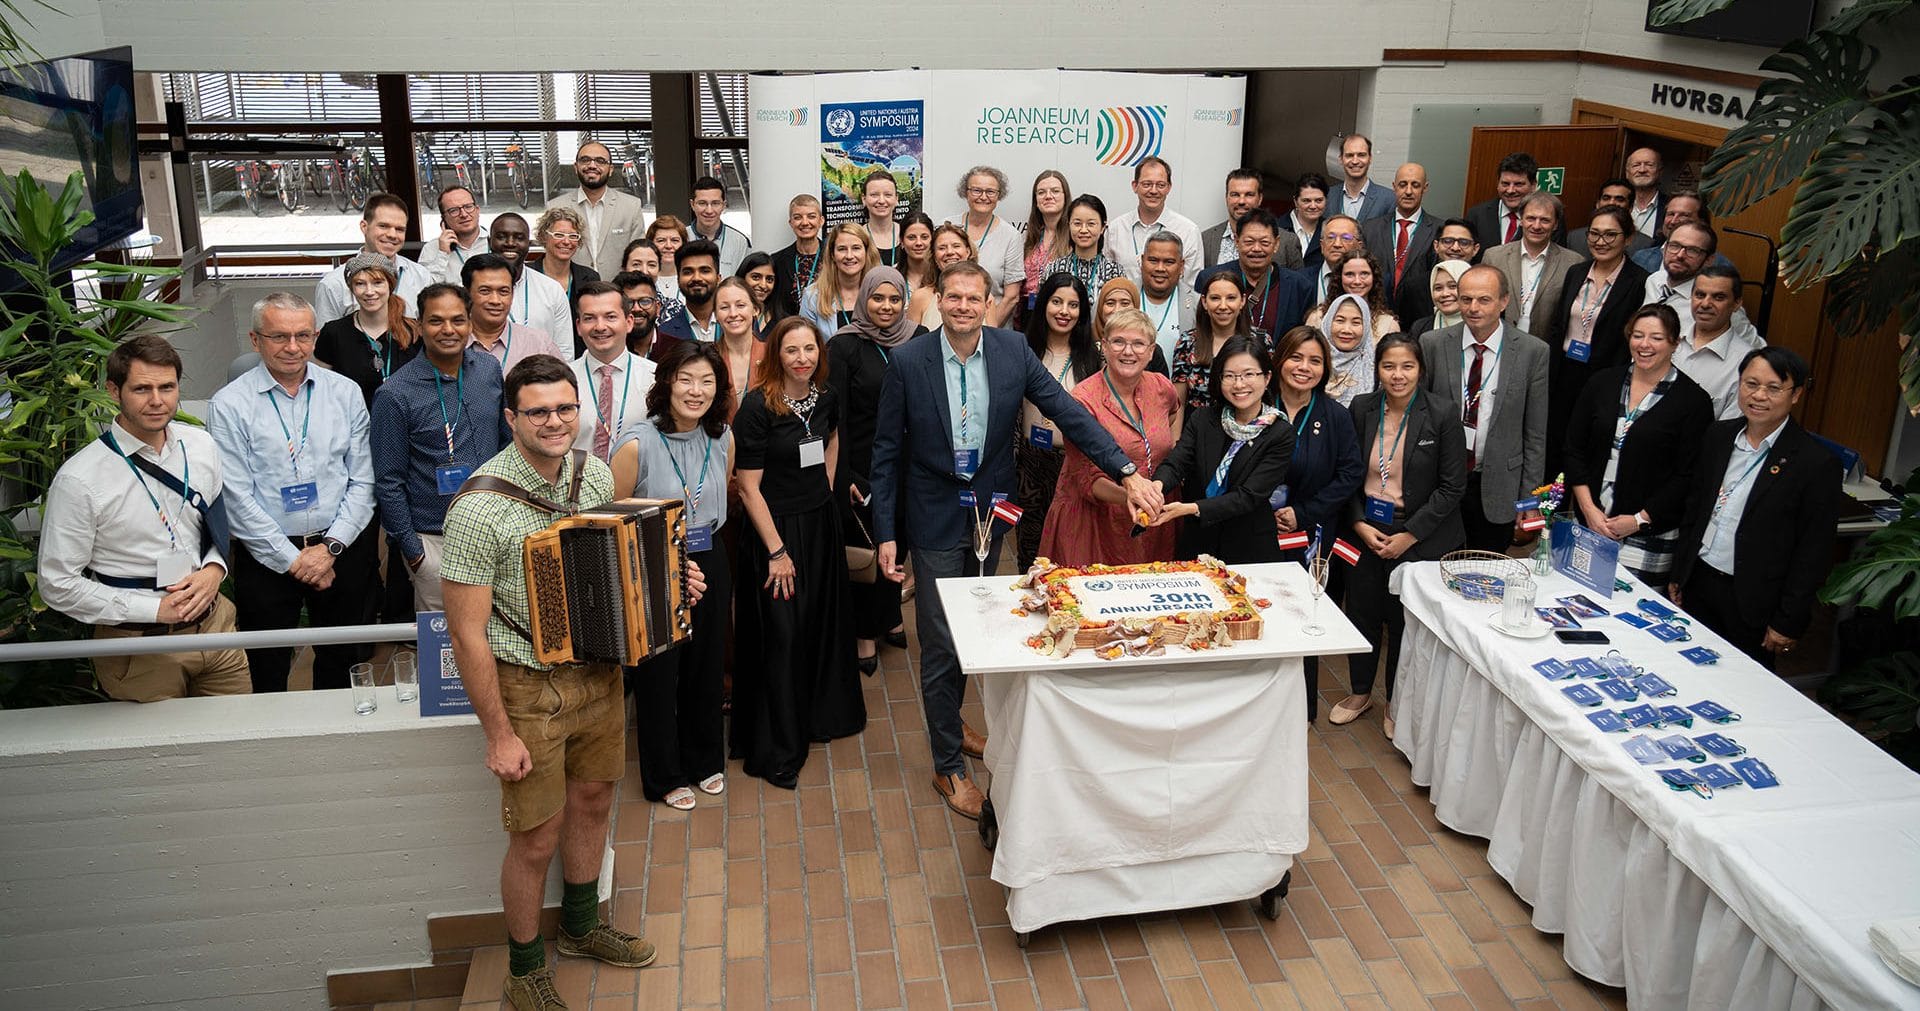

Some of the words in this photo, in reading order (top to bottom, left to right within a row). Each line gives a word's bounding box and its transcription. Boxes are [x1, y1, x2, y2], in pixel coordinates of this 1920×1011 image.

[860, 114, 919, 128] SYMPOSIUM
[977, 107, 1089, 125] JOANNEUM
[977, 127, 1089, 145] RESEARCH
[1117, 580, 1201, 591] SYMPOSIUM
[1150, 592, 1212, 604] 30th
[1100, 602, 1214, 614] ANNIVERSARY
